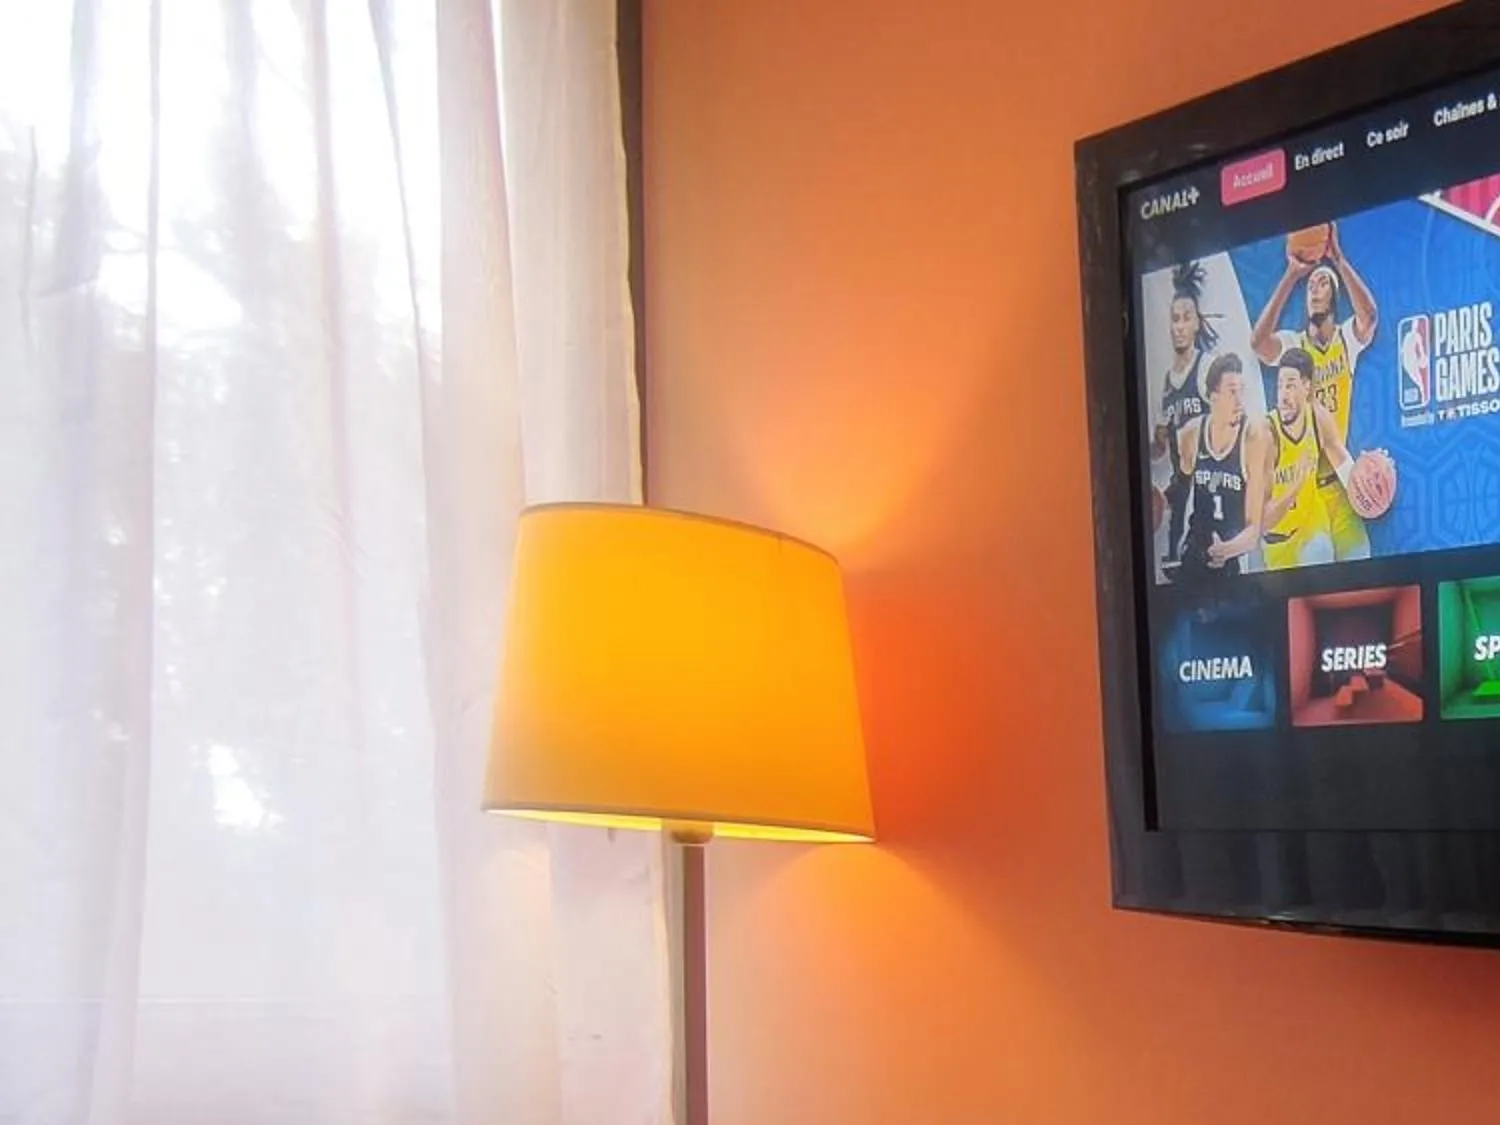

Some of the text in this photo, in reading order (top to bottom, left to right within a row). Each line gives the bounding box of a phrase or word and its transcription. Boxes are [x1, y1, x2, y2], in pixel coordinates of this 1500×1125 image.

[1433, 96, 1485, 127] Chaînes
[1487, 92, 1497, 111] &
[1366, 120, 1409, 148] Ce soir
[1294, 142, 1346, 171] En direct
[1232, 163, 1274, 189] Accueil
[1434, 301, 1493, 358] PARIS
[1435, 346, 1500, 402] GAMES
[1213, 496, 1224, 520] 1
[1179, 656, 1253, 682] CINEMA
[1321, 644, 1387, 672] SERIES
